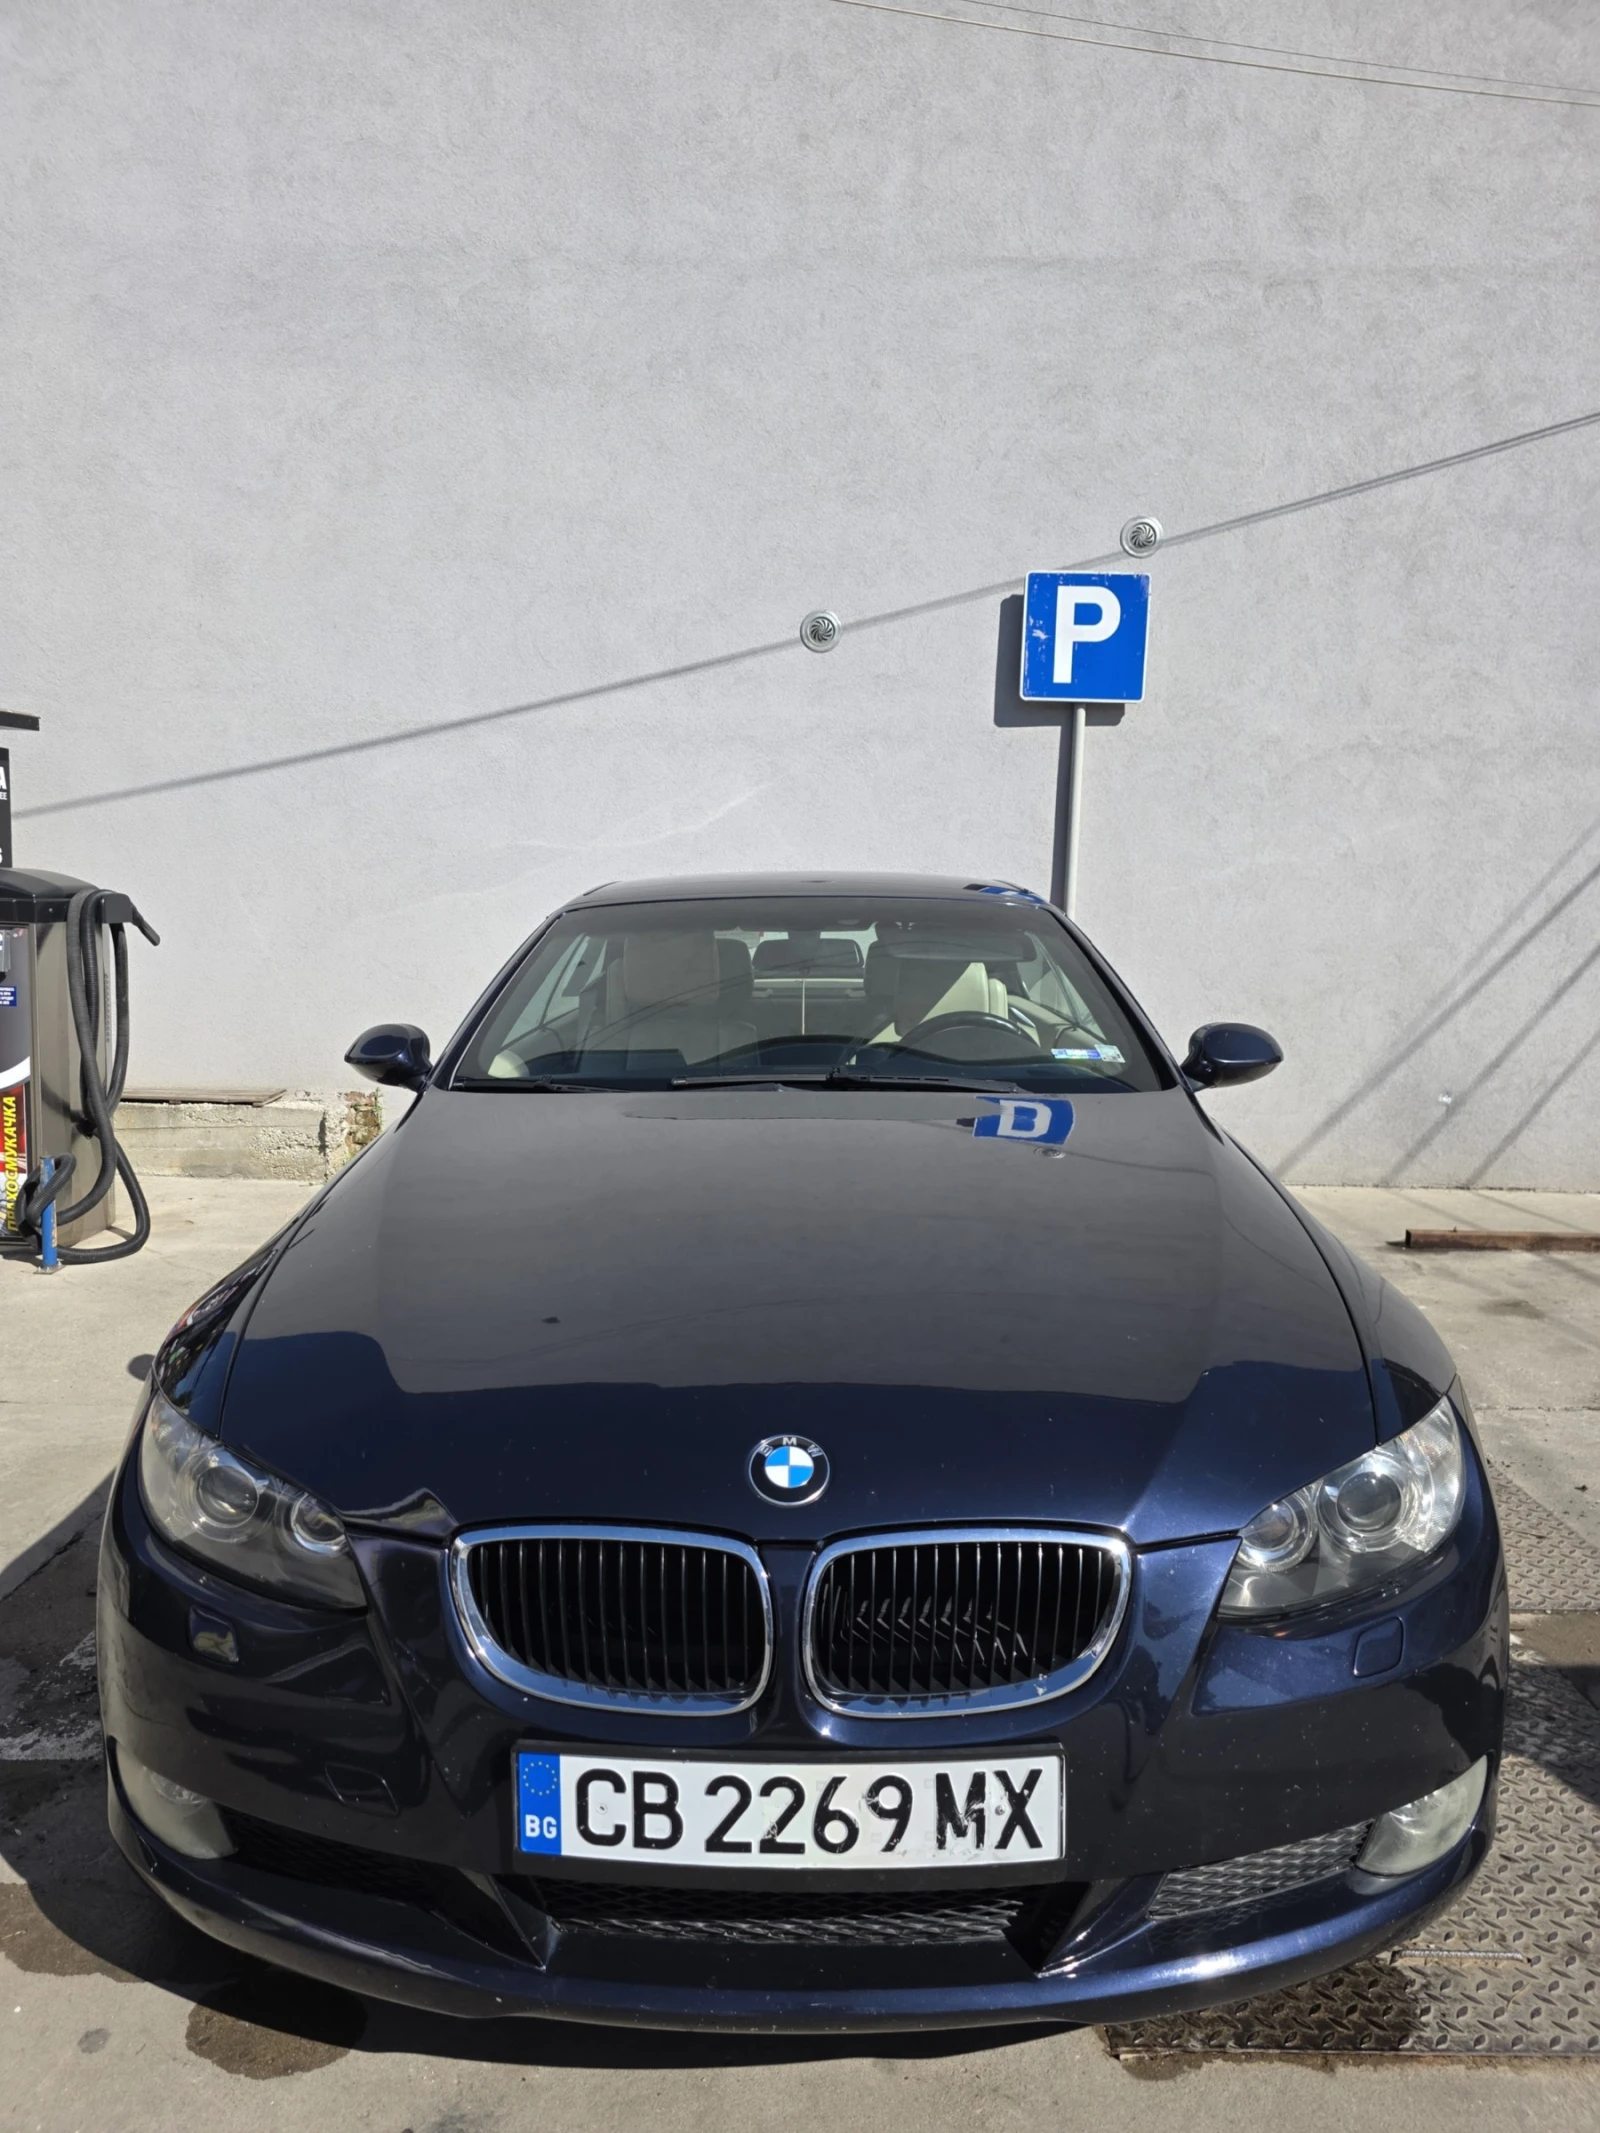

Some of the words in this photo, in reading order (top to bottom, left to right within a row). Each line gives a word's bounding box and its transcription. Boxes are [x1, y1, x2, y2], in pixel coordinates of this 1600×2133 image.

[1053, 586, 1121, 683] P
[758, 1437, 823, 1457] BMW
[524, 1815, 557, 1838] BG
[704, 1774, 913, 1854] 2269
